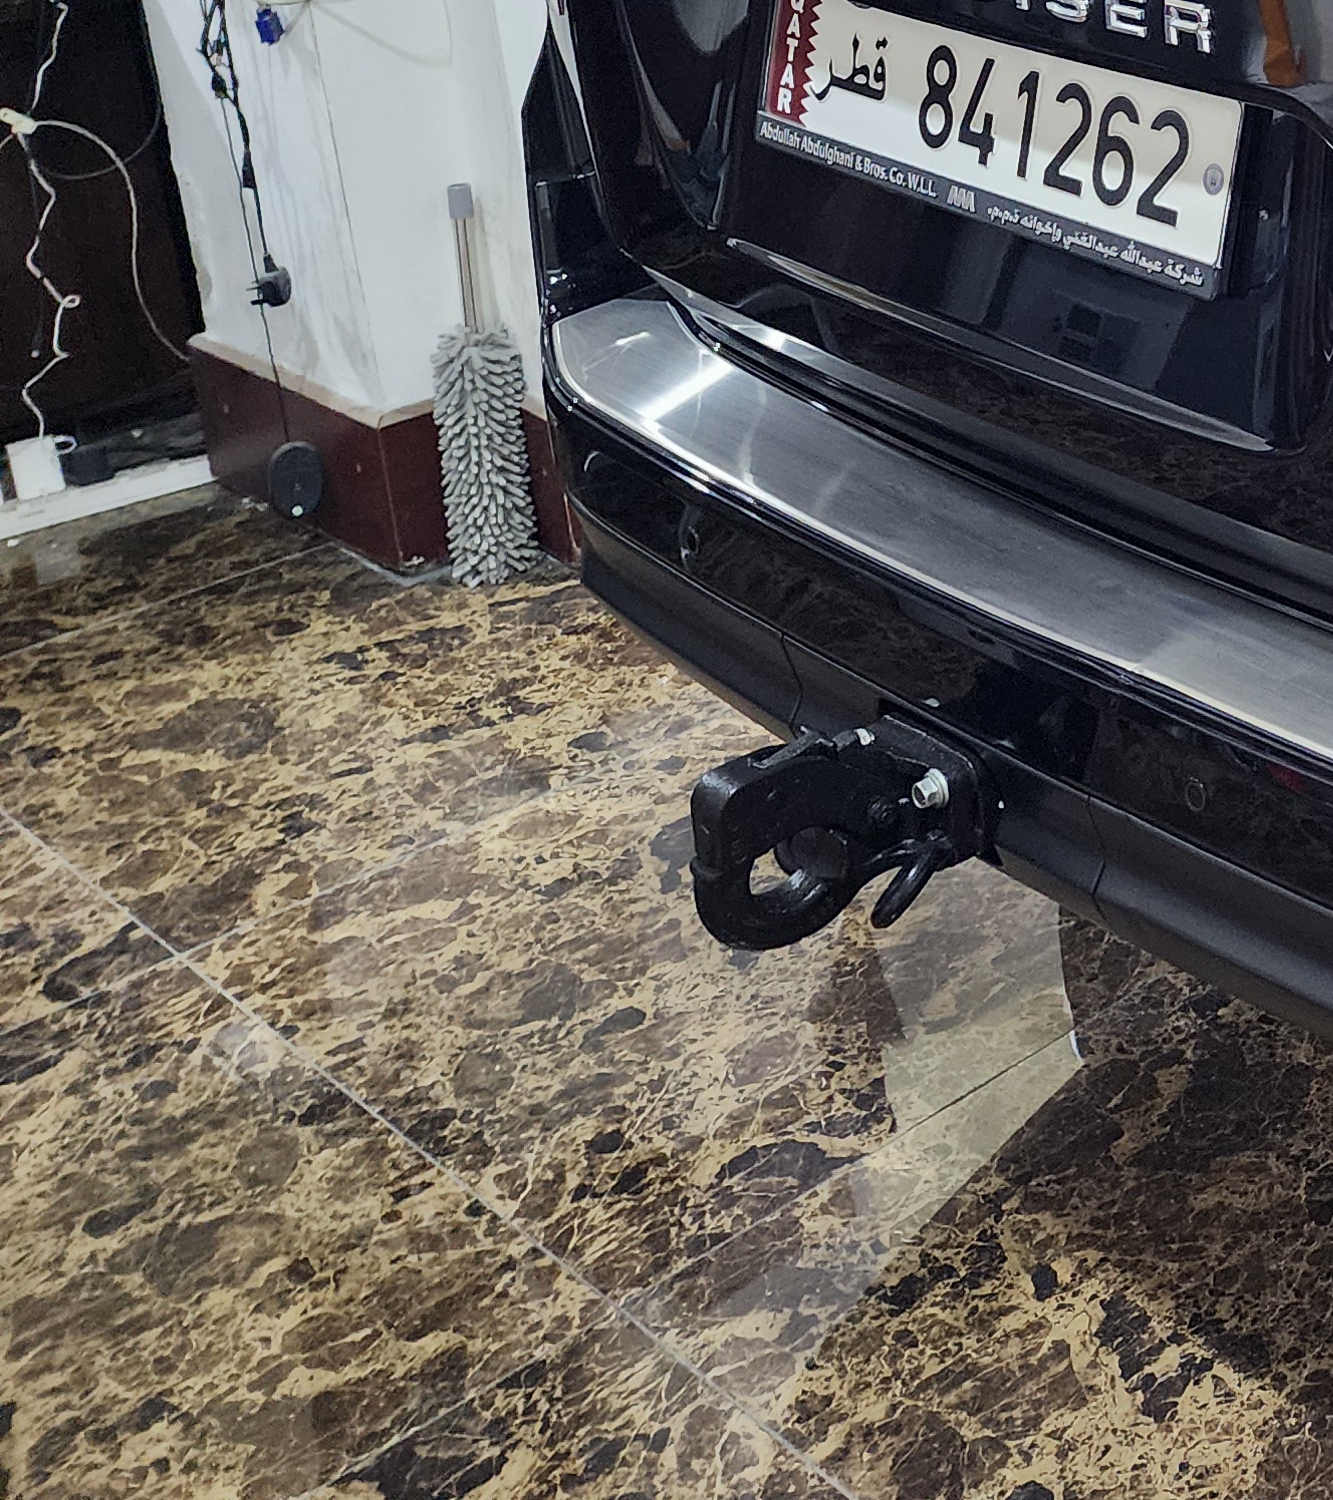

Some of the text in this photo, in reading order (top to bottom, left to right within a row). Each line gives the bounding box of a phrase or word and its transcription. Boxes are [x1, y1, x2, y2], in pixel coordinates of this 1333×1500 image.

[810, 32, 887, 101] قطر
[760, 121, 801, 150] Abdullah
[801, 135, 854, 166] Abdulghani
[854, 155, 863, 171] &
[919, 45, 1190, 227] 841262
[1164, 258, 1204, 286] شركة
